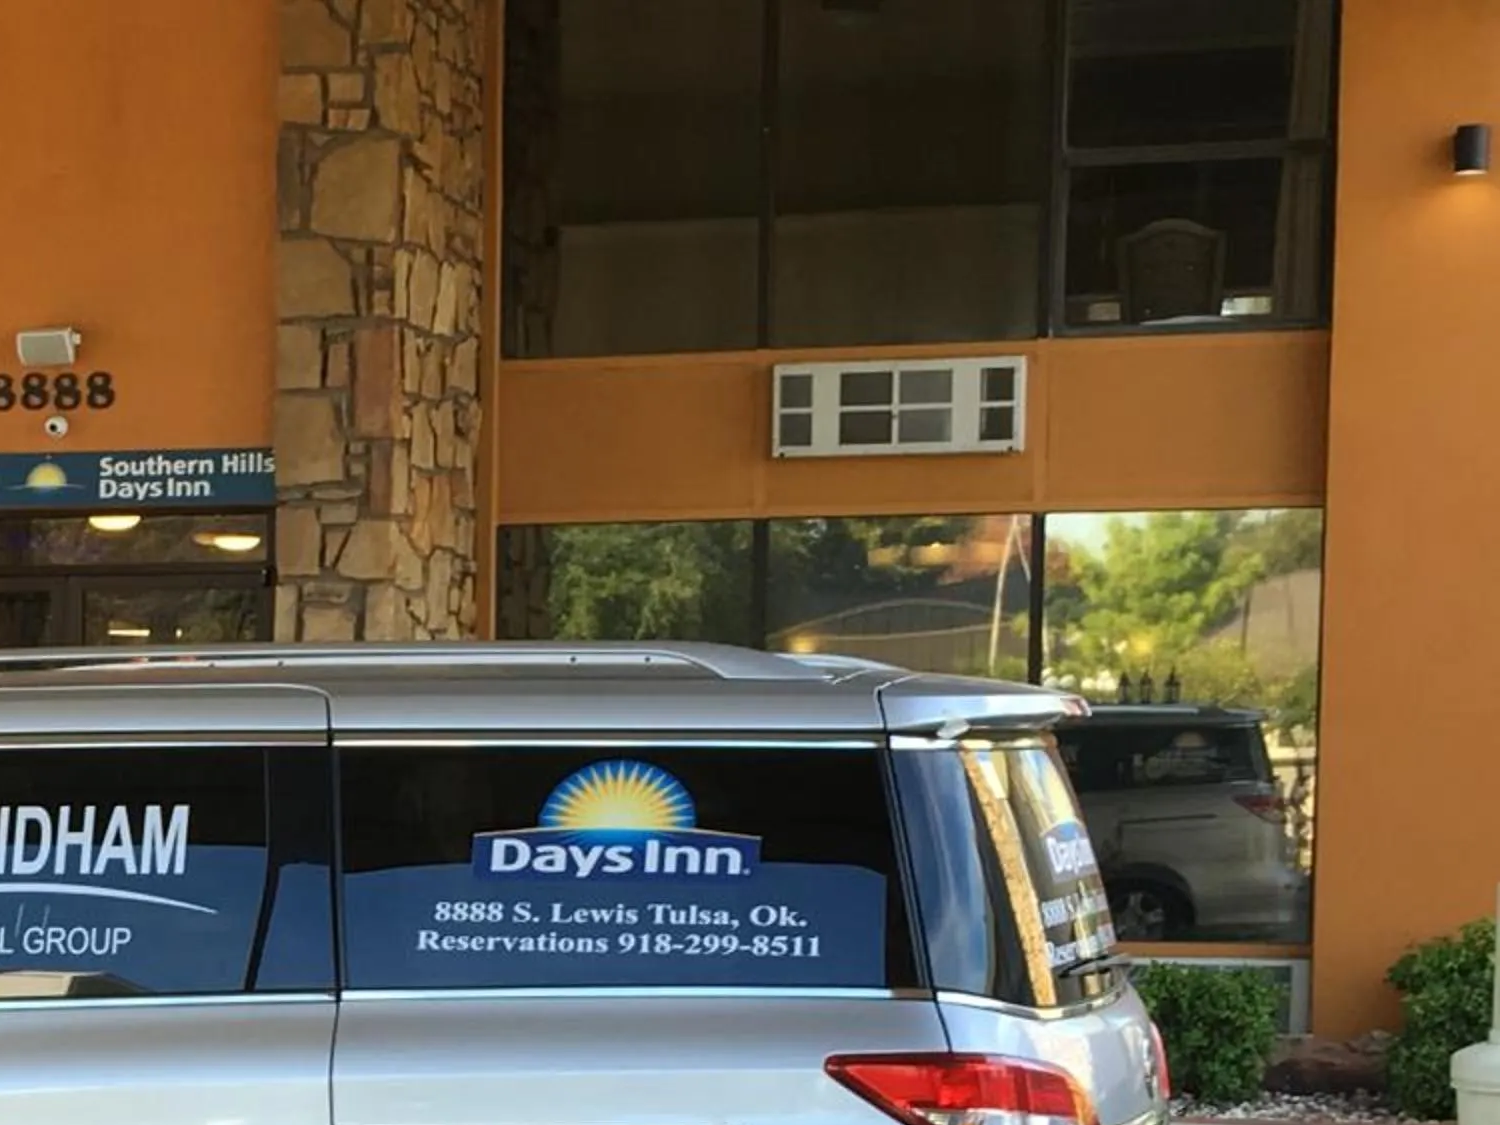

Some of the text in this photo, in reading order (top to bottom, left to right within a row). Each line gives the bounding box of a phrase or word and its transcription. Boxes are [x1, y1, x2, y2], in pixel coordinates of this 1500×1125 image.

[99, 452, 276, 477] Southern Hills
[99, 478, 211, 501] Days Inn
[490, 838, 743, 878] Days Inn
[434, 901, 808, 930] 8888 S. Lewis Tulsa, Ok.
[23, 926, 132, 955] GROUP
[417, 930, 820, 957] Reservations 918-299-8511
